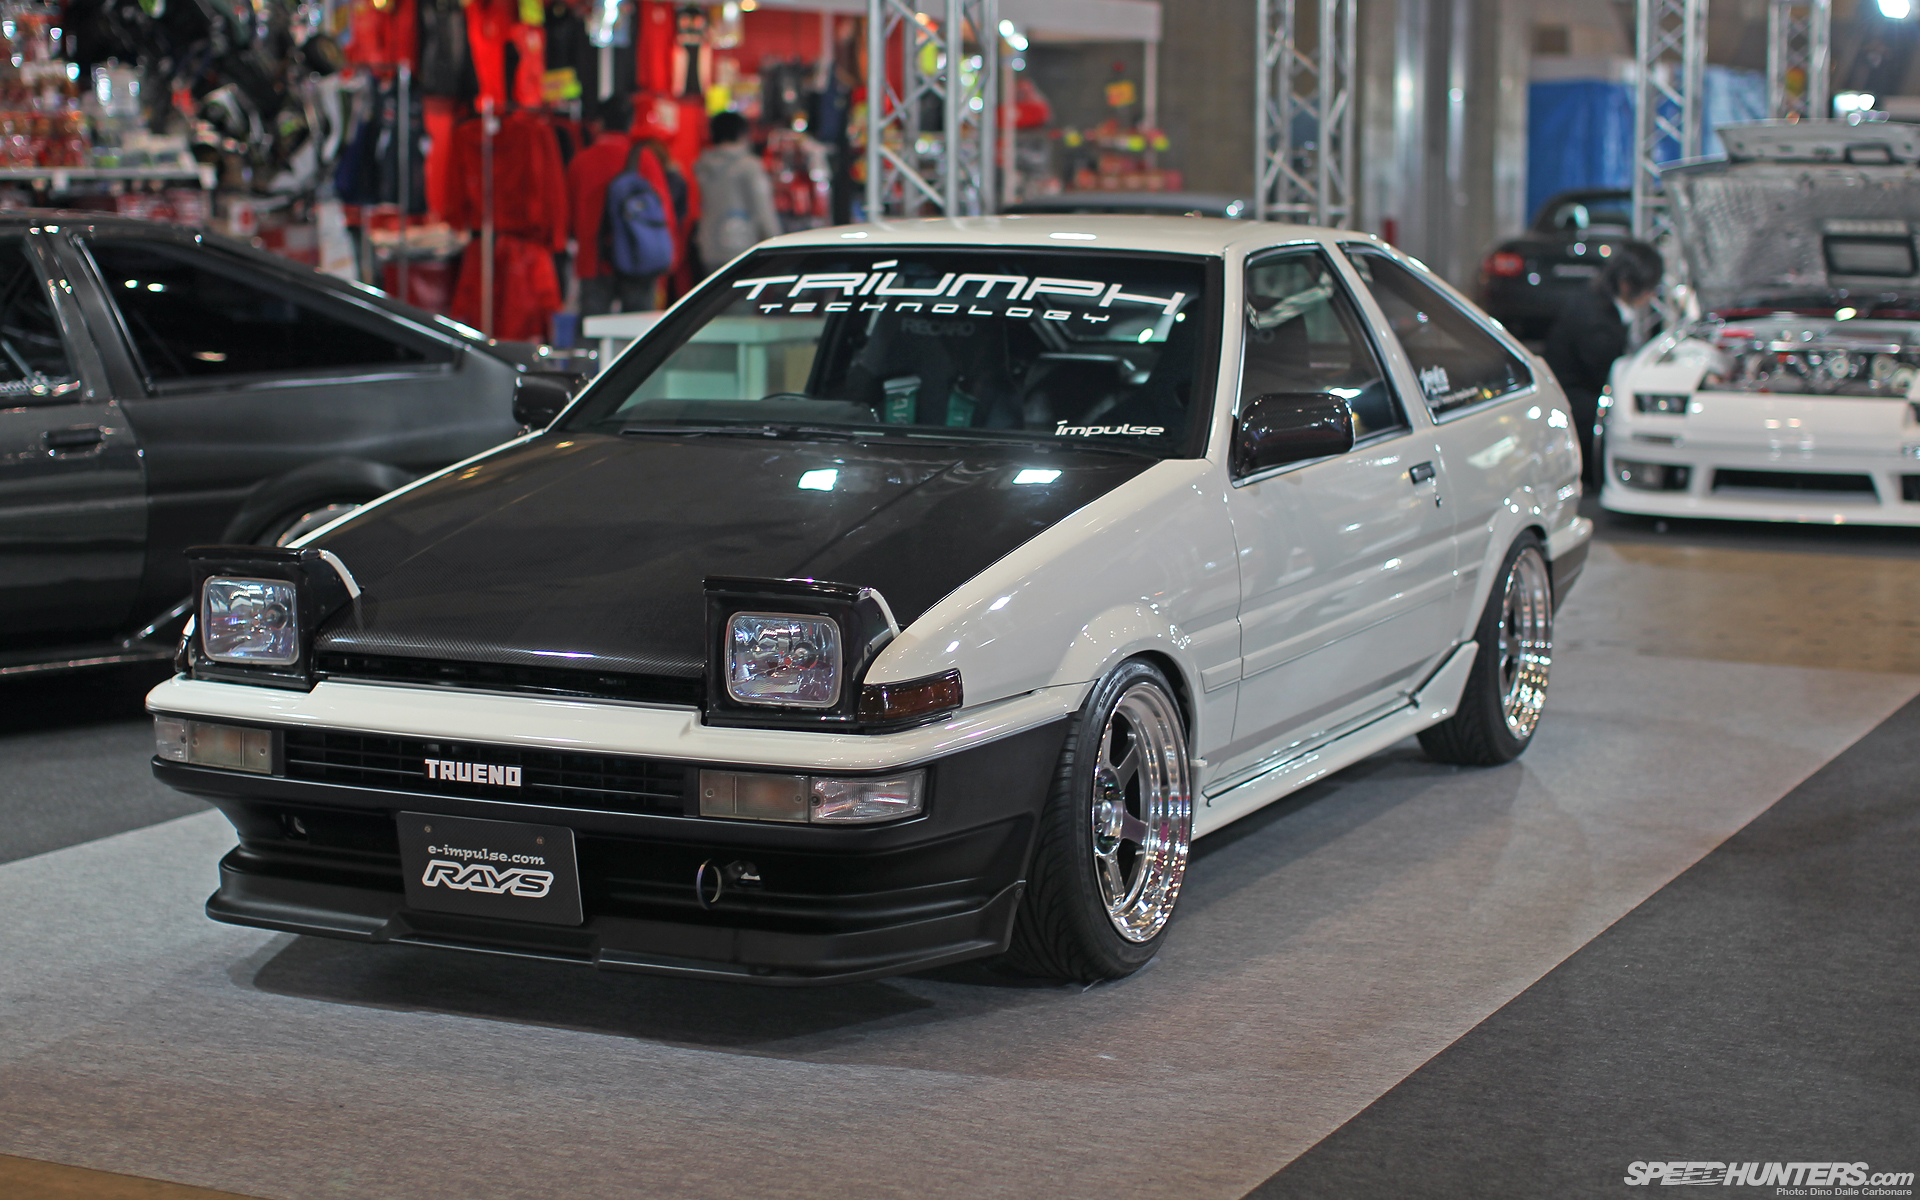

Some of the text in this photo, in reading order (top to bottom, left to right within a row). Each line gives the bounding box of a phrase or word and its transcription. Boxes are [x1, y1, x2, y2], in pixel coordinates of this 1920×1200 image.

[759, 302, 1110, 323] TECHNOLOGY
[1054, 419, 1165, 437] impulse
[424, 758, 522, 787] TRUENO
[427, 844, 546, 866] e-impulse.com
[421, 859, 555, 899] RAYS
